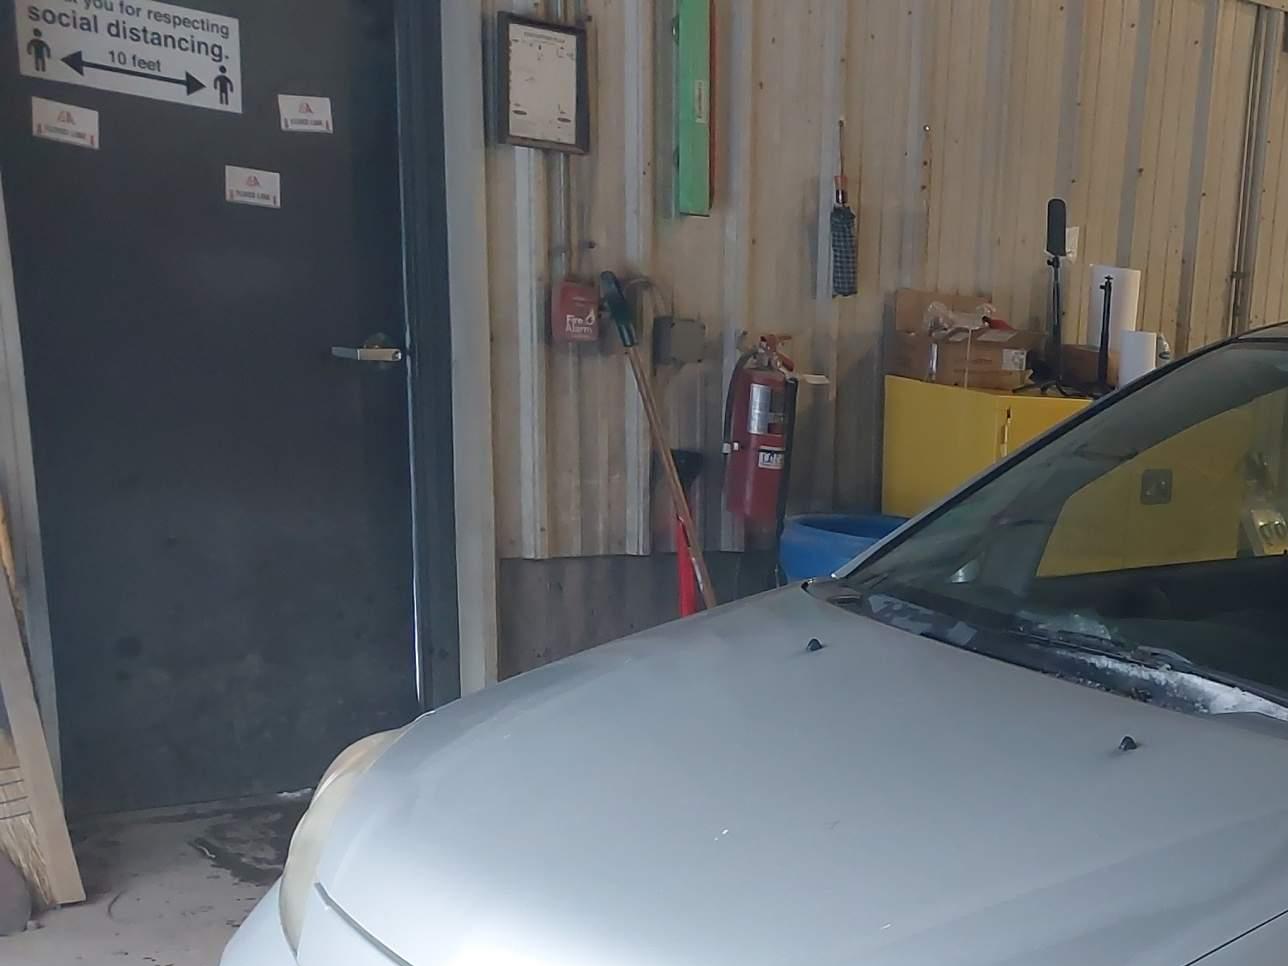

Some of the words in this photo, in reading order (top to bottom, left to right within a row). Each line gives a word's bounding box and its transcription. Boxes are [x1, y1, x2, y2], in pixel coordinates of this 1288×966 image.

[119, 0, 141, 17] for
[147, 9, 230, 39] respecting
[28, 5, 99, 33] social
[107, 20, 230, 63] distancing.
[108, 51, 127, 66] 10
[132, 55, 161, 73] feet
[565, 324, 592, 335] Alarm
[566, 314, 584, 325] Fire
